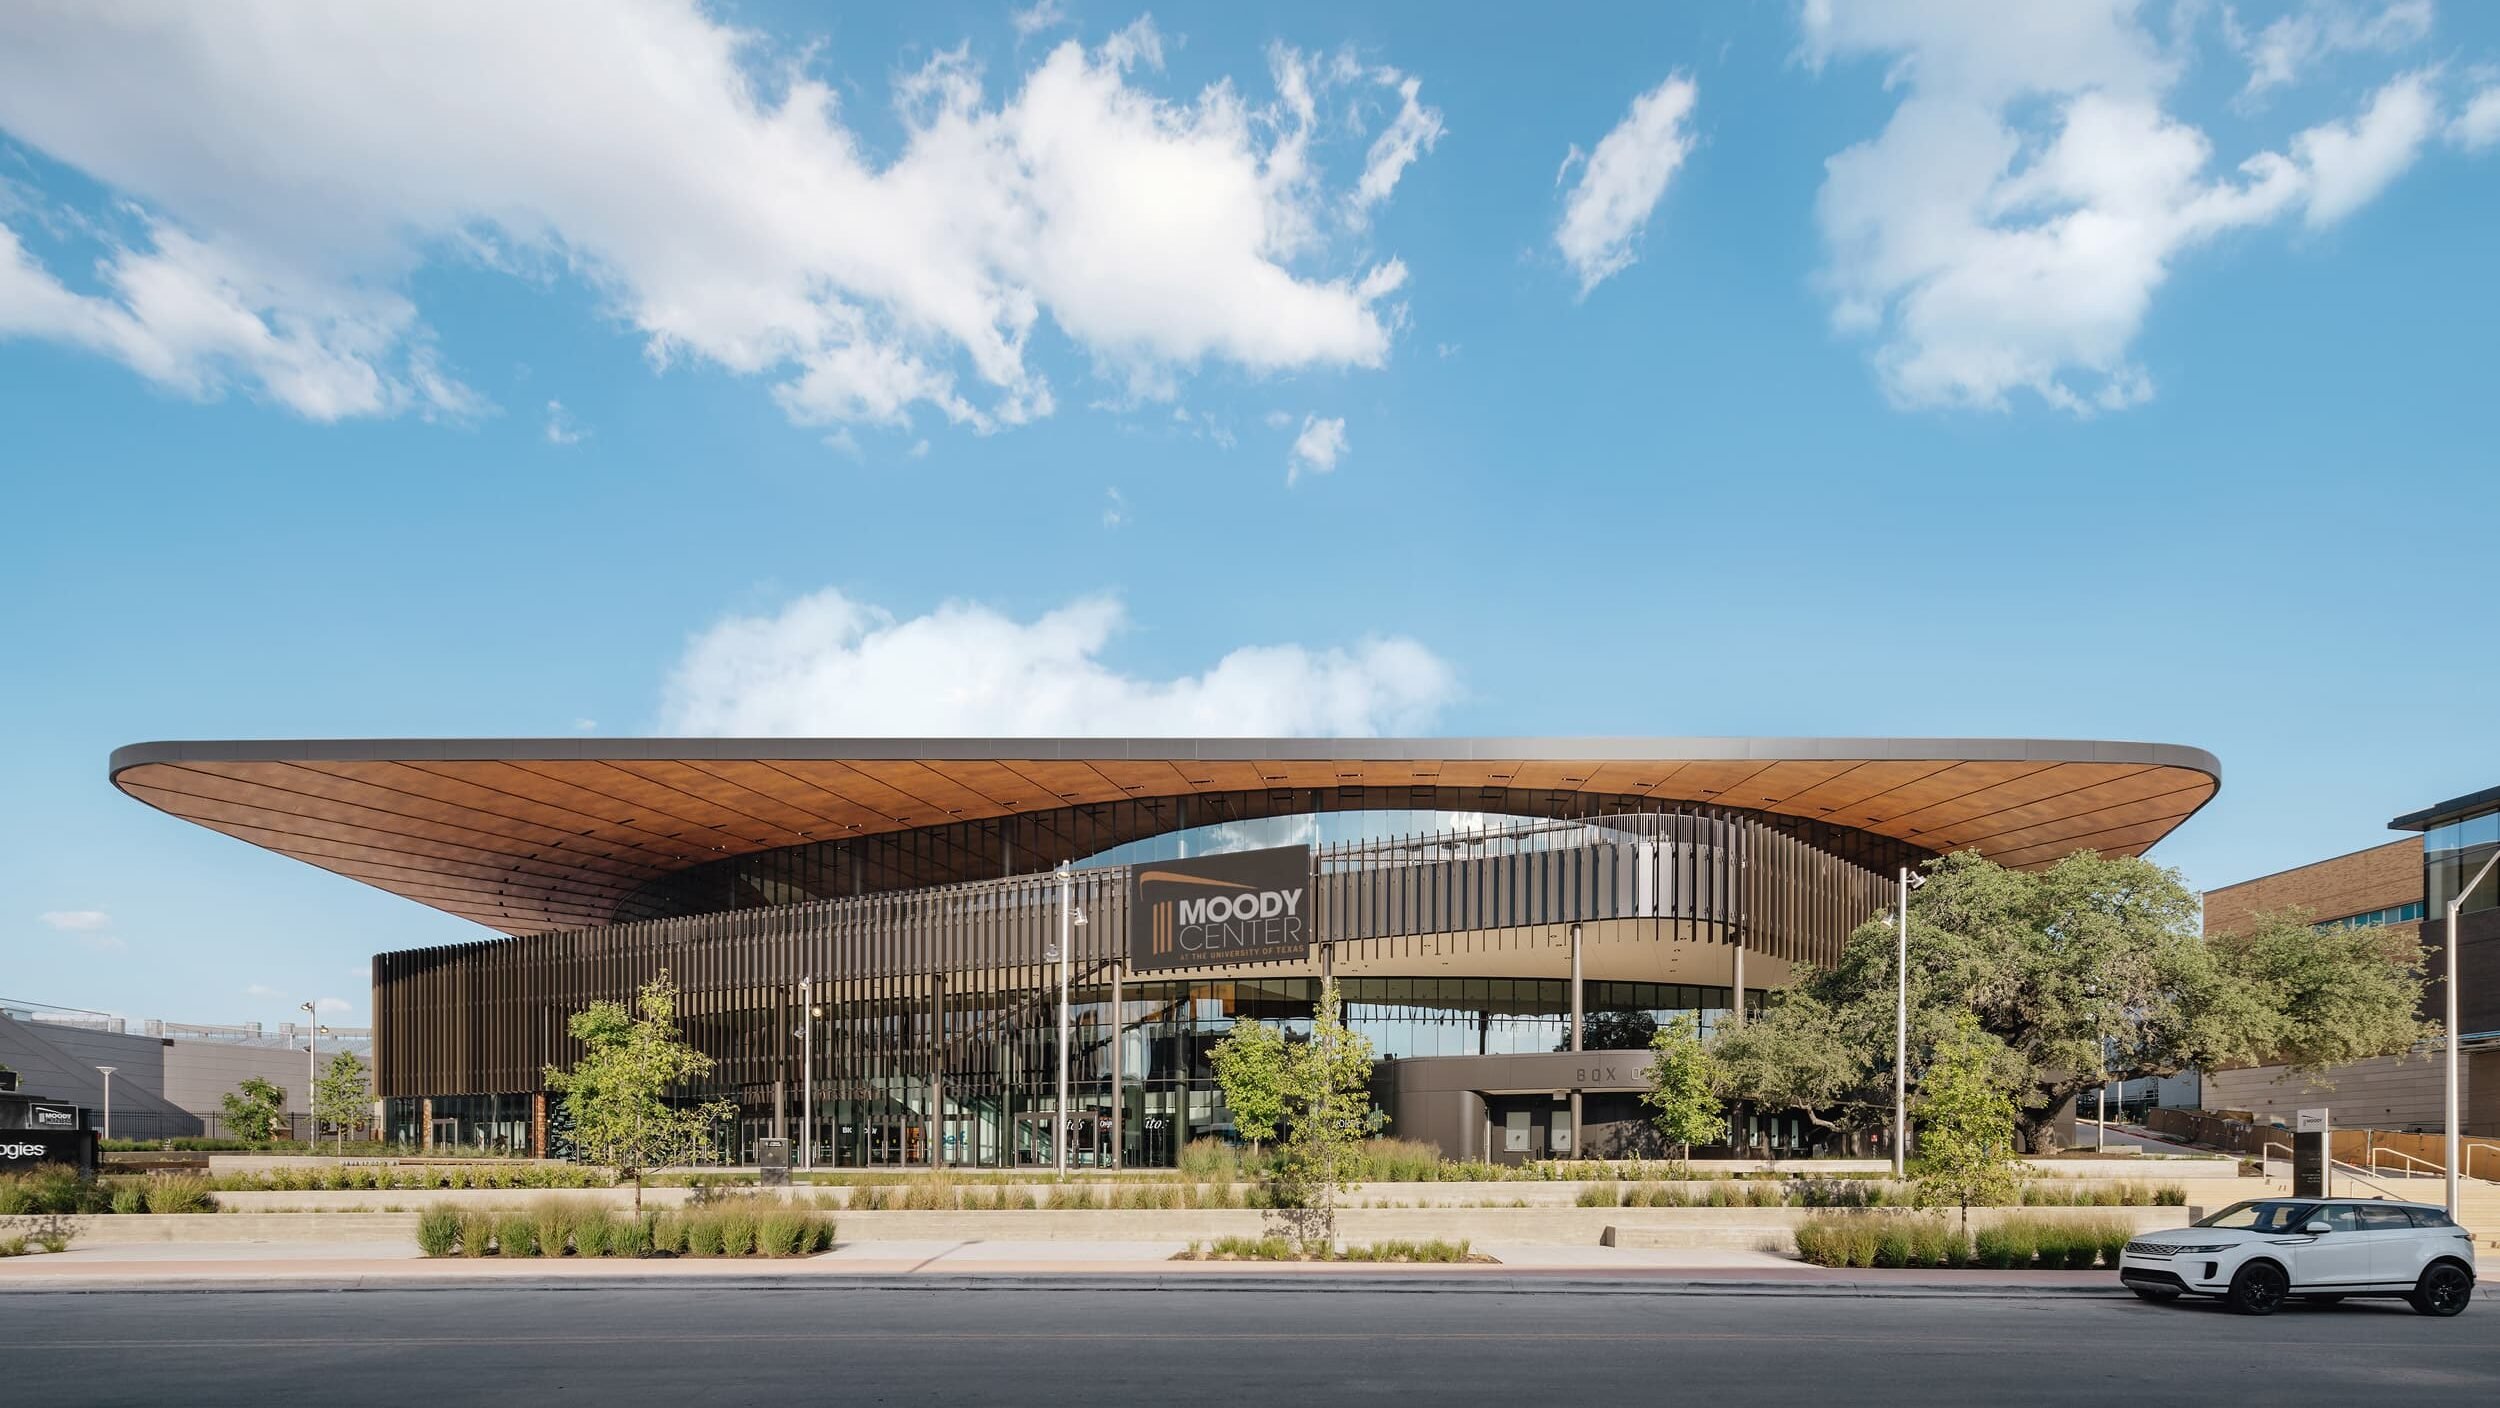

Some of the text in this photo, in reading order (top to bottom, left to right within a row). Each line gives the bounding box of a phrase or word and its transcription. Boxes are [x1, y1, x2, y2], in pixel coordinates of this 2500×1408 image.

[1179, 888, 1303, 926] MOODY
[1179, 916, 1302, 951] CENTER
[1192, 952, 1207, 960] THE
[1210, 947, 1259, 959] UNIVERSITY
[1262, 946, 1273, 955] OF
[1276, 944, 1305, 954] TEXAS
[1576, 1067, 1617, 1082] BOX
